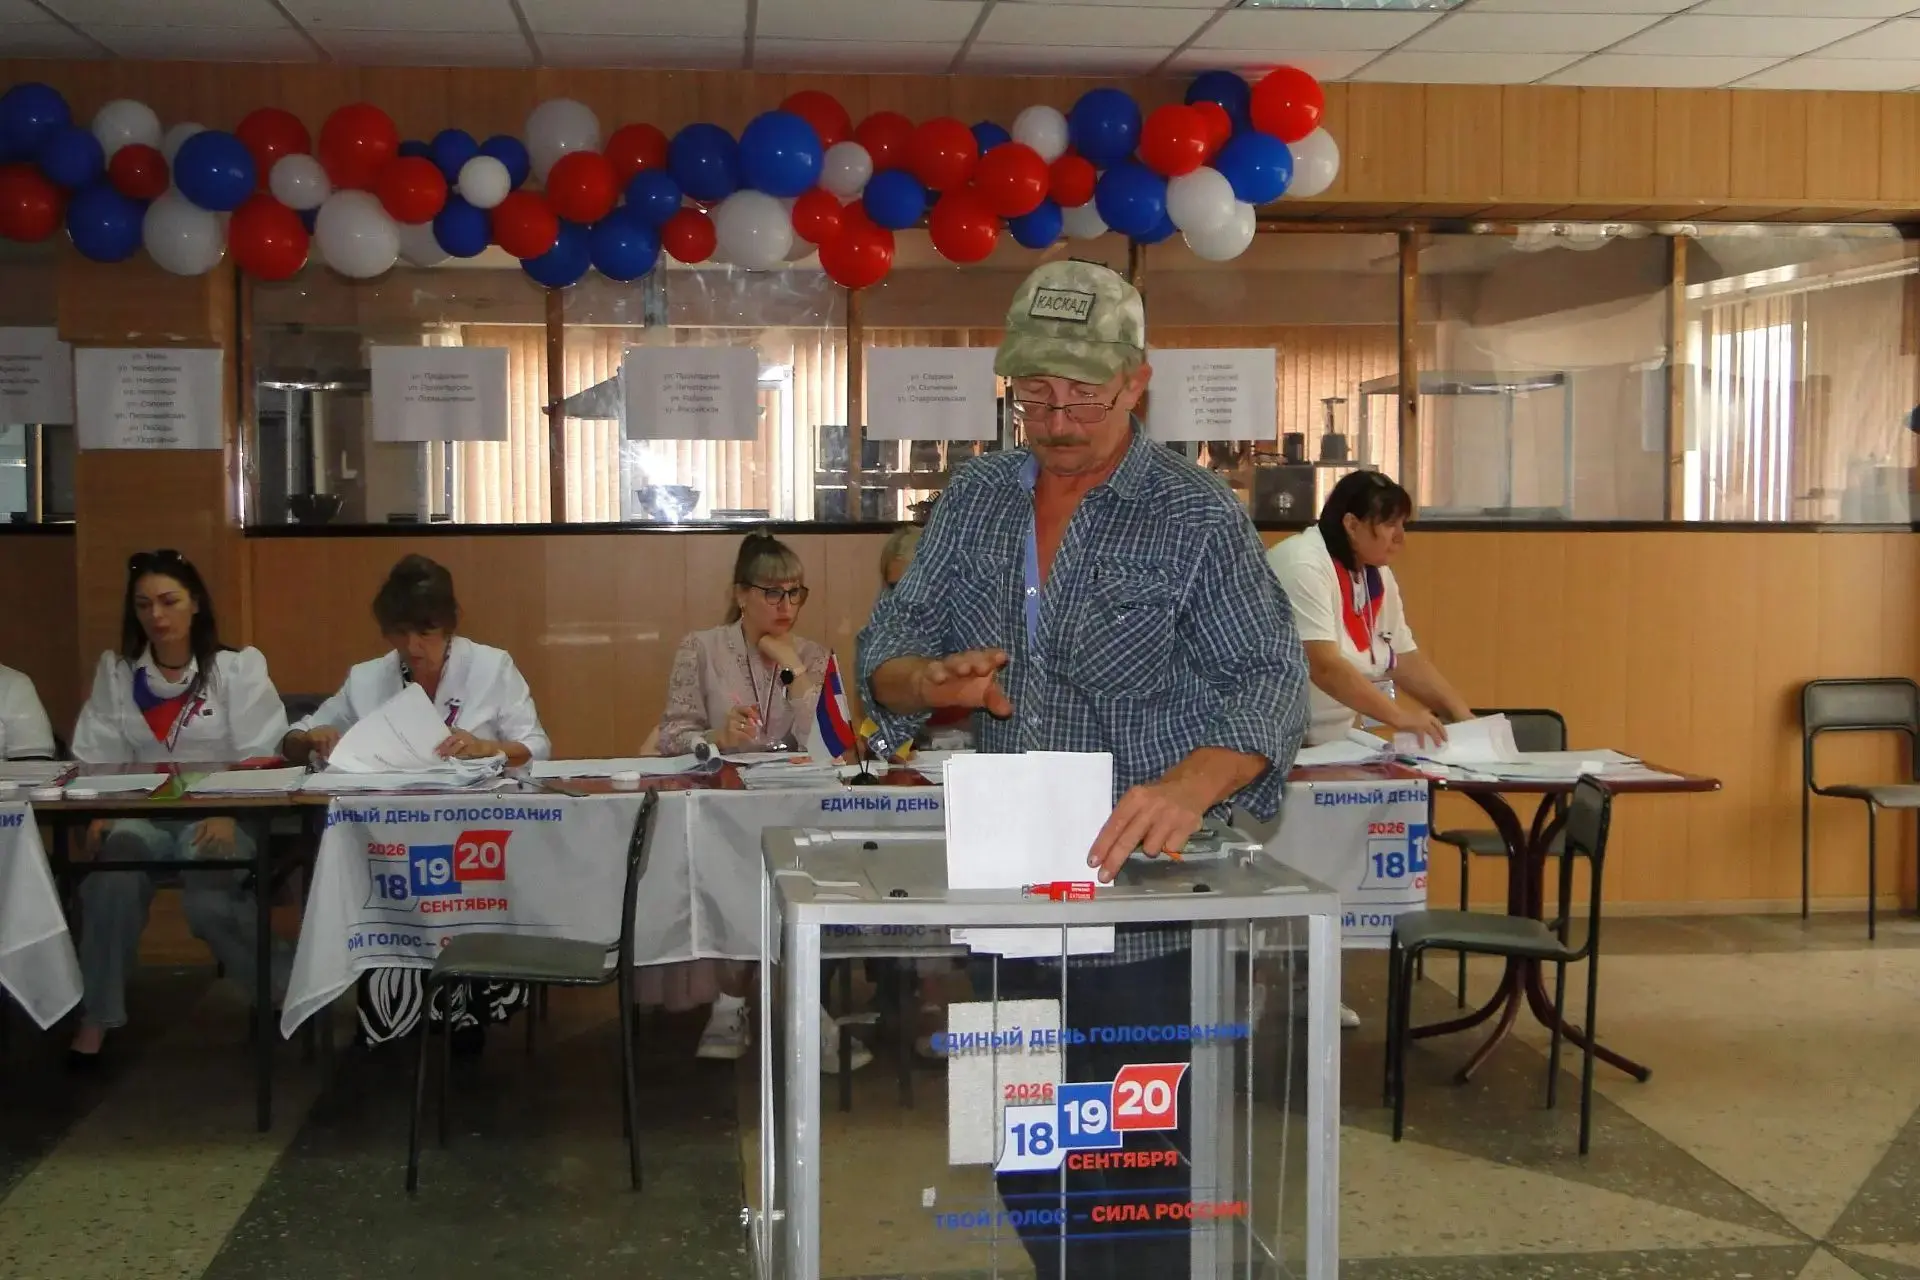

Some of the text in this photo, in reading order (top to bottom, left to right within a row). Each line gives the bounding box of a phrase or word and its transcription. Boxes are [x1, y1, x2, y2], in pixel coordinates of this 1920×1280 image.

[1036, 295, 1089, 316] КАСКАД
[821, 795, 940, 813] ЕДИНЫЙ ДЕНЬ
[1314, 789, 1428, 806] ЕДИНЫЙ ДЕНЬ
[325, 807, 562, 827] ДИНЫЙ ДЕНЬ ГОЛОСОВАНИЯ
[1368, 822, 1405, 835] 2026
[367, 842, 407, 856] 2026
[459, 841, 501, 870] 20
[414, 858, 450, 886] 19
[1372, 852, 1405, 879] 18
[374, 873, 409, 901] 18
[420, 897, 508, 914] СЕНТЯБРЯ
[1360, 913, 1392, 927] ГОЛ
[367, 932, 422, 947] ГОЛОС
[931, 1022, 1250, 1051] ЕДИНЫЙ ДЕНЬ ГОЛОСОВАНИЯ
[1004, 1083, 1054, 1099] 2026
[1117, 1081, 1173, 1116] 20
[1063, 1100, 1108, 1135] 19
[1010, 1122, 1054, 1156] 18
[1068, 1151, 1178, 1170] СЕНТЯБРЯ
[936, 1208, 990, 1230] ТВОЙ
[998, 1208, 1068, 1228] ГОЛОС
[1092, 1203, 1150, 1222] СИЛА
